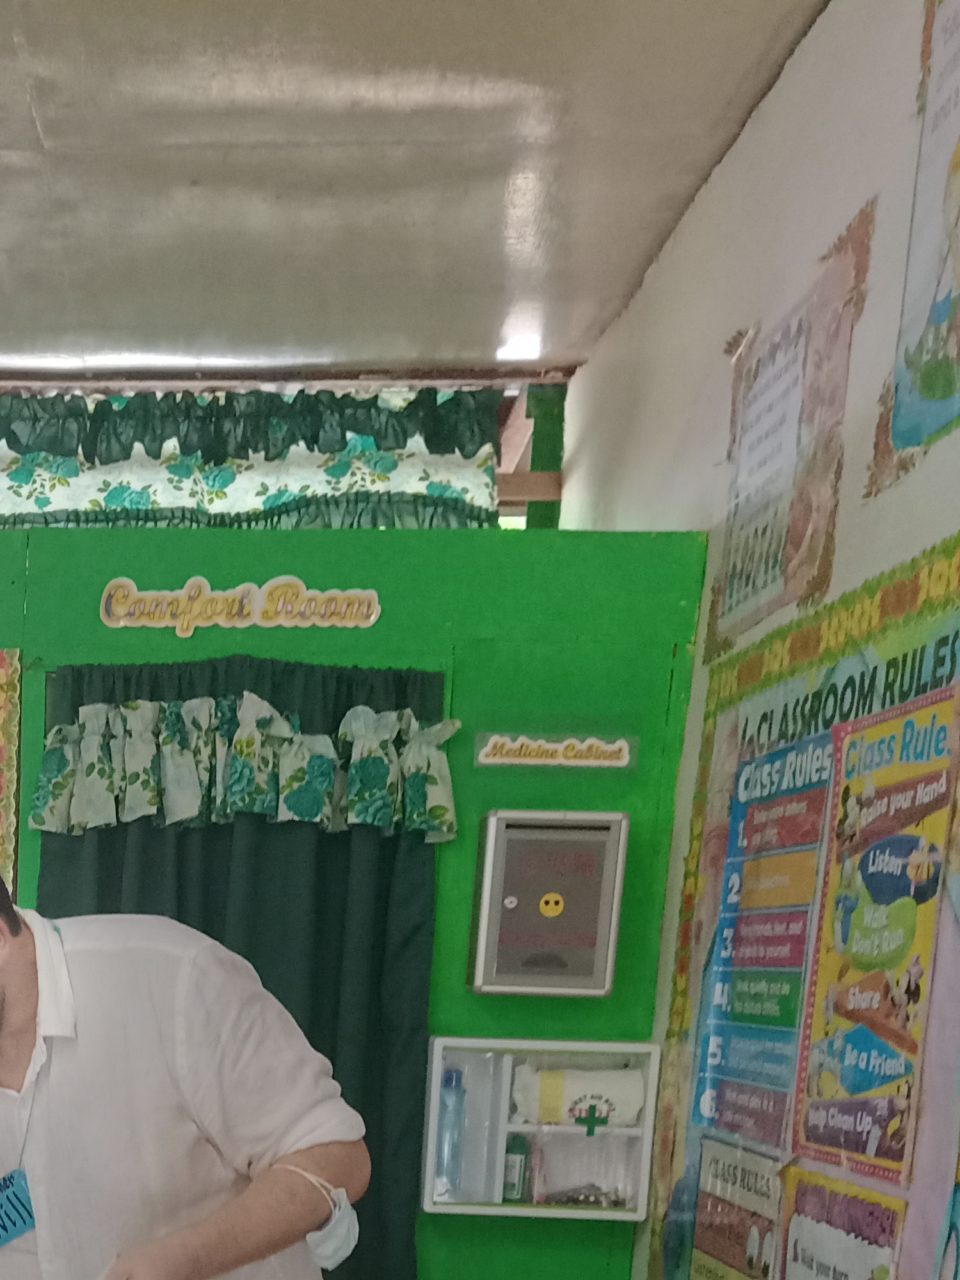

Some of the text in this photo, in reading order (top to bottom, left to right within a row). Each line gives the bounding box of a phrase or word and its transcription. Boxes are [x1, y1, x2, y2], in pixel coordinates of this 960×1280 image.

[104, 583, 373, 631] Comfort Room
[756, 666, 878, 750] CLASSROOM
[881, 629, 960, 709] RULES
[485, 740, 624, 761] Medicine Cabinet
[845, 734, 896, 780] Class
[738, 744, 833, 804] Class Rules
[868, 848, 903, 876] Listen
[848, 985, 881, 1010] Share
[868, 1048, 906, 1076] Friend
[828, 1107, 854, 1132] Clean
[856, 1110, 873, 1141] Up
